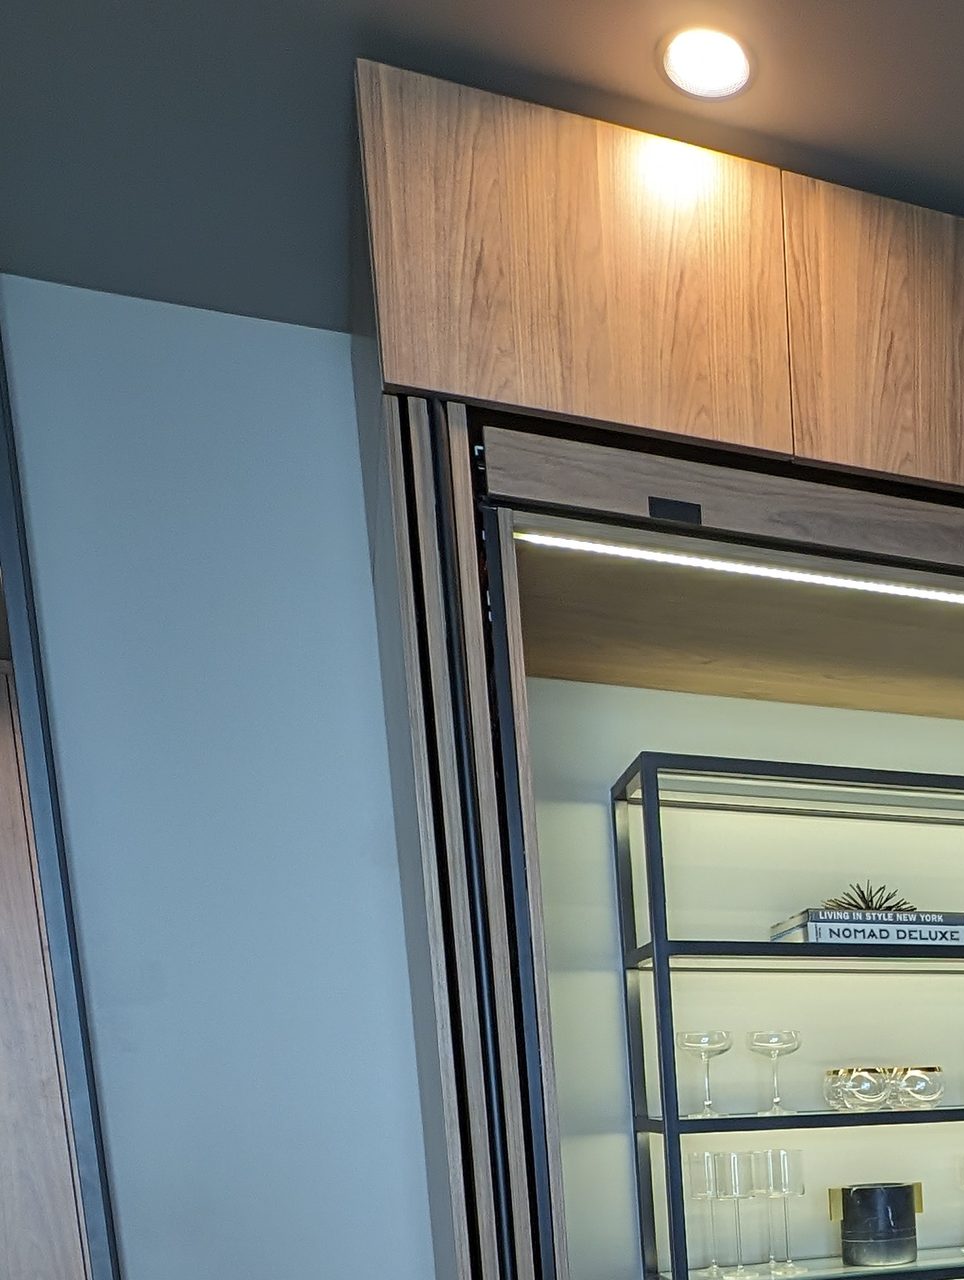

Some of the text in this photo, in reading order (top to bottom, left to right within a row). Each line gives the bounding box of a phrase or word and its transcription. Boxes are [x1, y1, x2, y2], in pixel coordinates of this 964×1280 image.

[818, 911, 944, 923] LIVING IN STYLE NEW YORK
[828, 927, 890, 940] NOMAD
[896, 929, 960, 941] DELUXE
